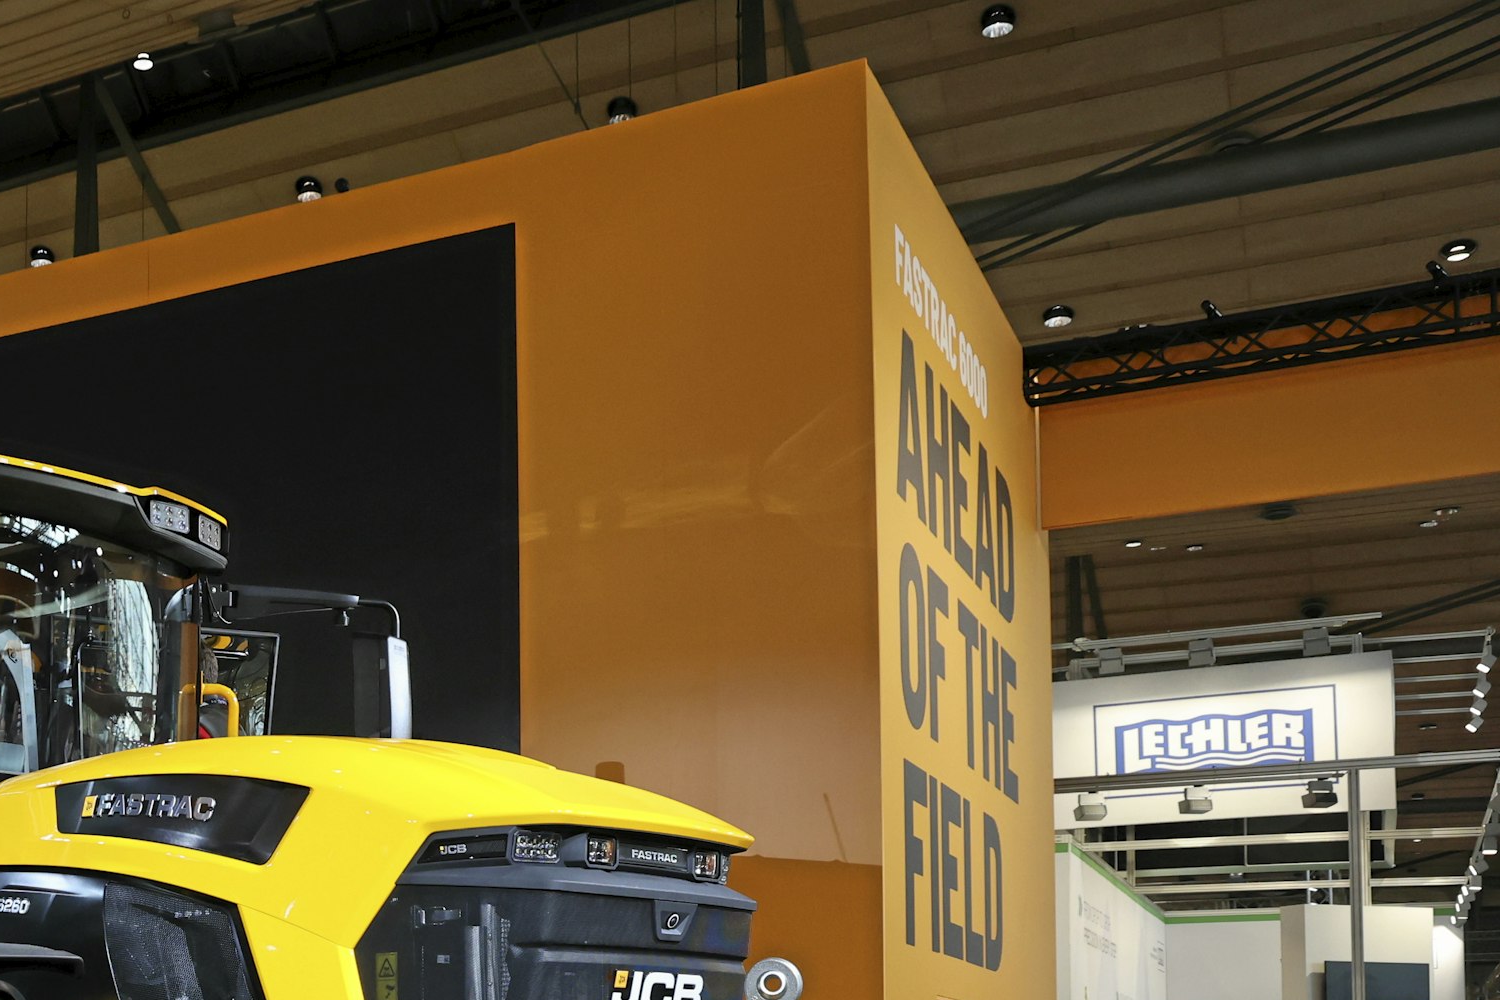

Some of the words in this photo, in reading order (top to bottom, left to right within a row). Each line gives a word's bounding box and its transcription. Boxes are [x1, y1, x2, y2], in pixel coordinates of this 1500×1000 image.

[894, 223, 958, 371] FASTRAC
[958, 330, 989, 419] 6000
[895, 327, 1015, 624] AHEAD
[899, 541, 951, 743] OF
[957, 598, 1020, 805] THE
[95, 792, 217, 822] FASTRAC
[1122, 713, 1306, 775] LECHLER
[439, 843, 468, 855] JCB
[630, 848, 678, 864] FASTRAC
[902, 754, 1004, 973] FIELD
